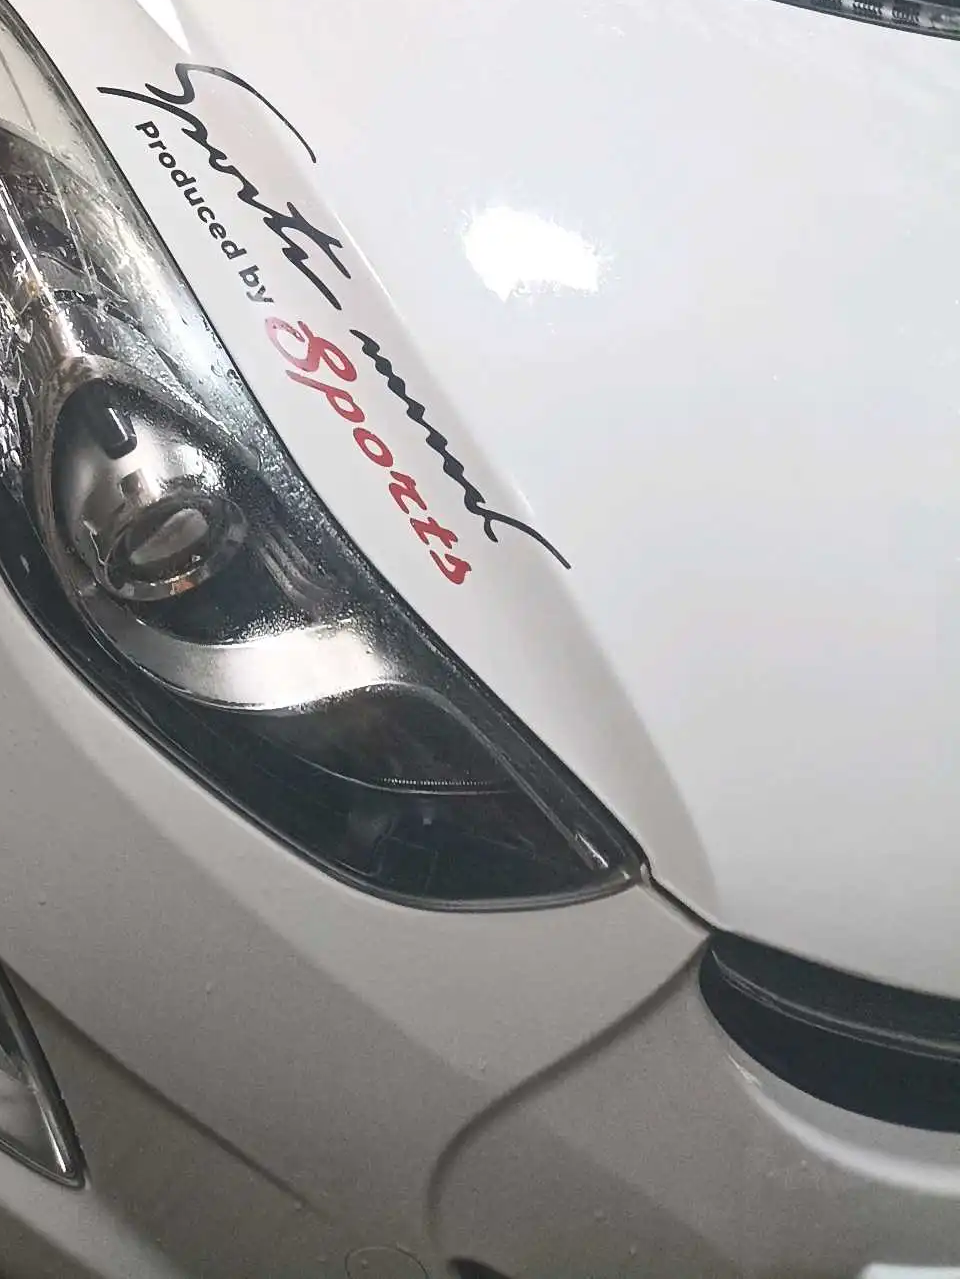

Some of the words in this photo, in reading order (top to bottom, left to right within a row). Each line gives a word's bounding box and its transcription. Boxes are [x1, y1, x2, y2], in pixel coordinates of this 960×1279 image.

[96, 62, 351, 310] Sports
[135, 120, 247, 261] Produced
[238, 265, 274, 306] by
[265, 316, 472, 585] Sports
